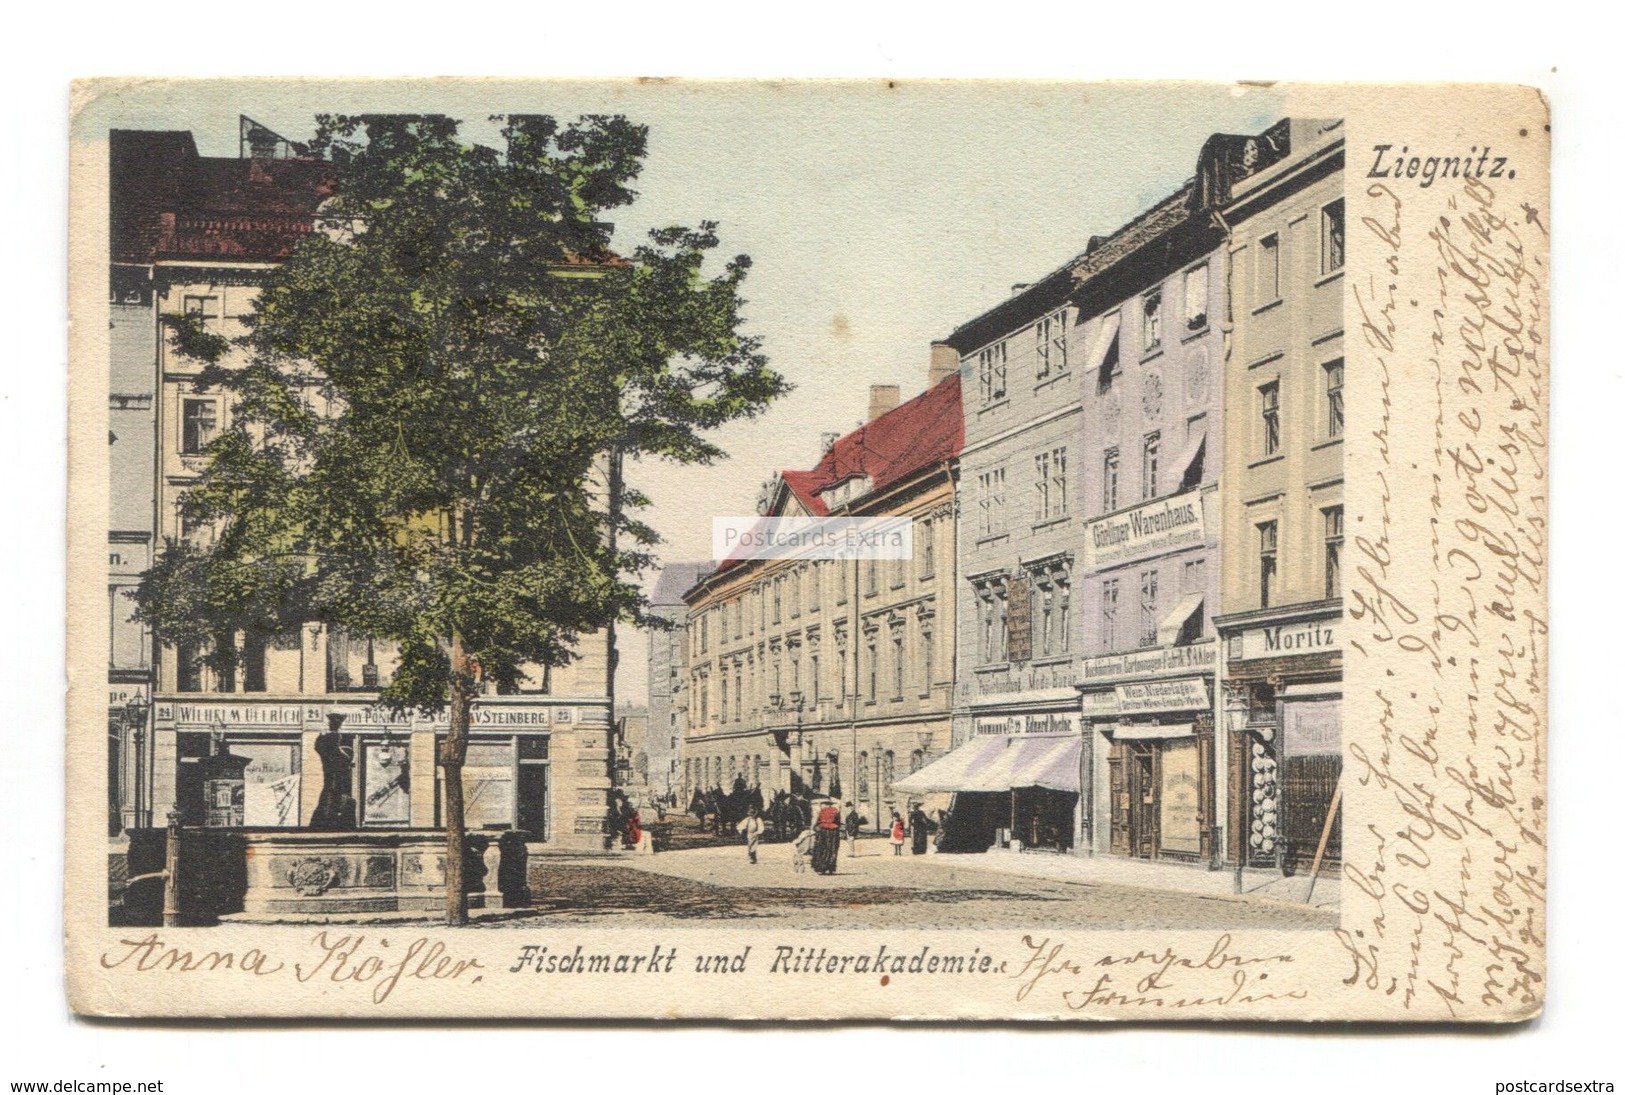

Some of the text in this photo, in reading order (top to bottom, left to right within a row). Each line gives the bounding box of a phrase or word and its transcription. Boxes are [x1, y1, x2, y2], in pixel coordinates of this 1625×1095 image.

[1366, 145, 1516, 188] Liegnitz.
[1129, 502, 1198, 538] Warenhaus.
[1263, 622, 1334, 652] Moritz
[158, 707, 172, 720] 24
[510, 946, 1000, 974] Fischmarkt und Ritterakademie.
